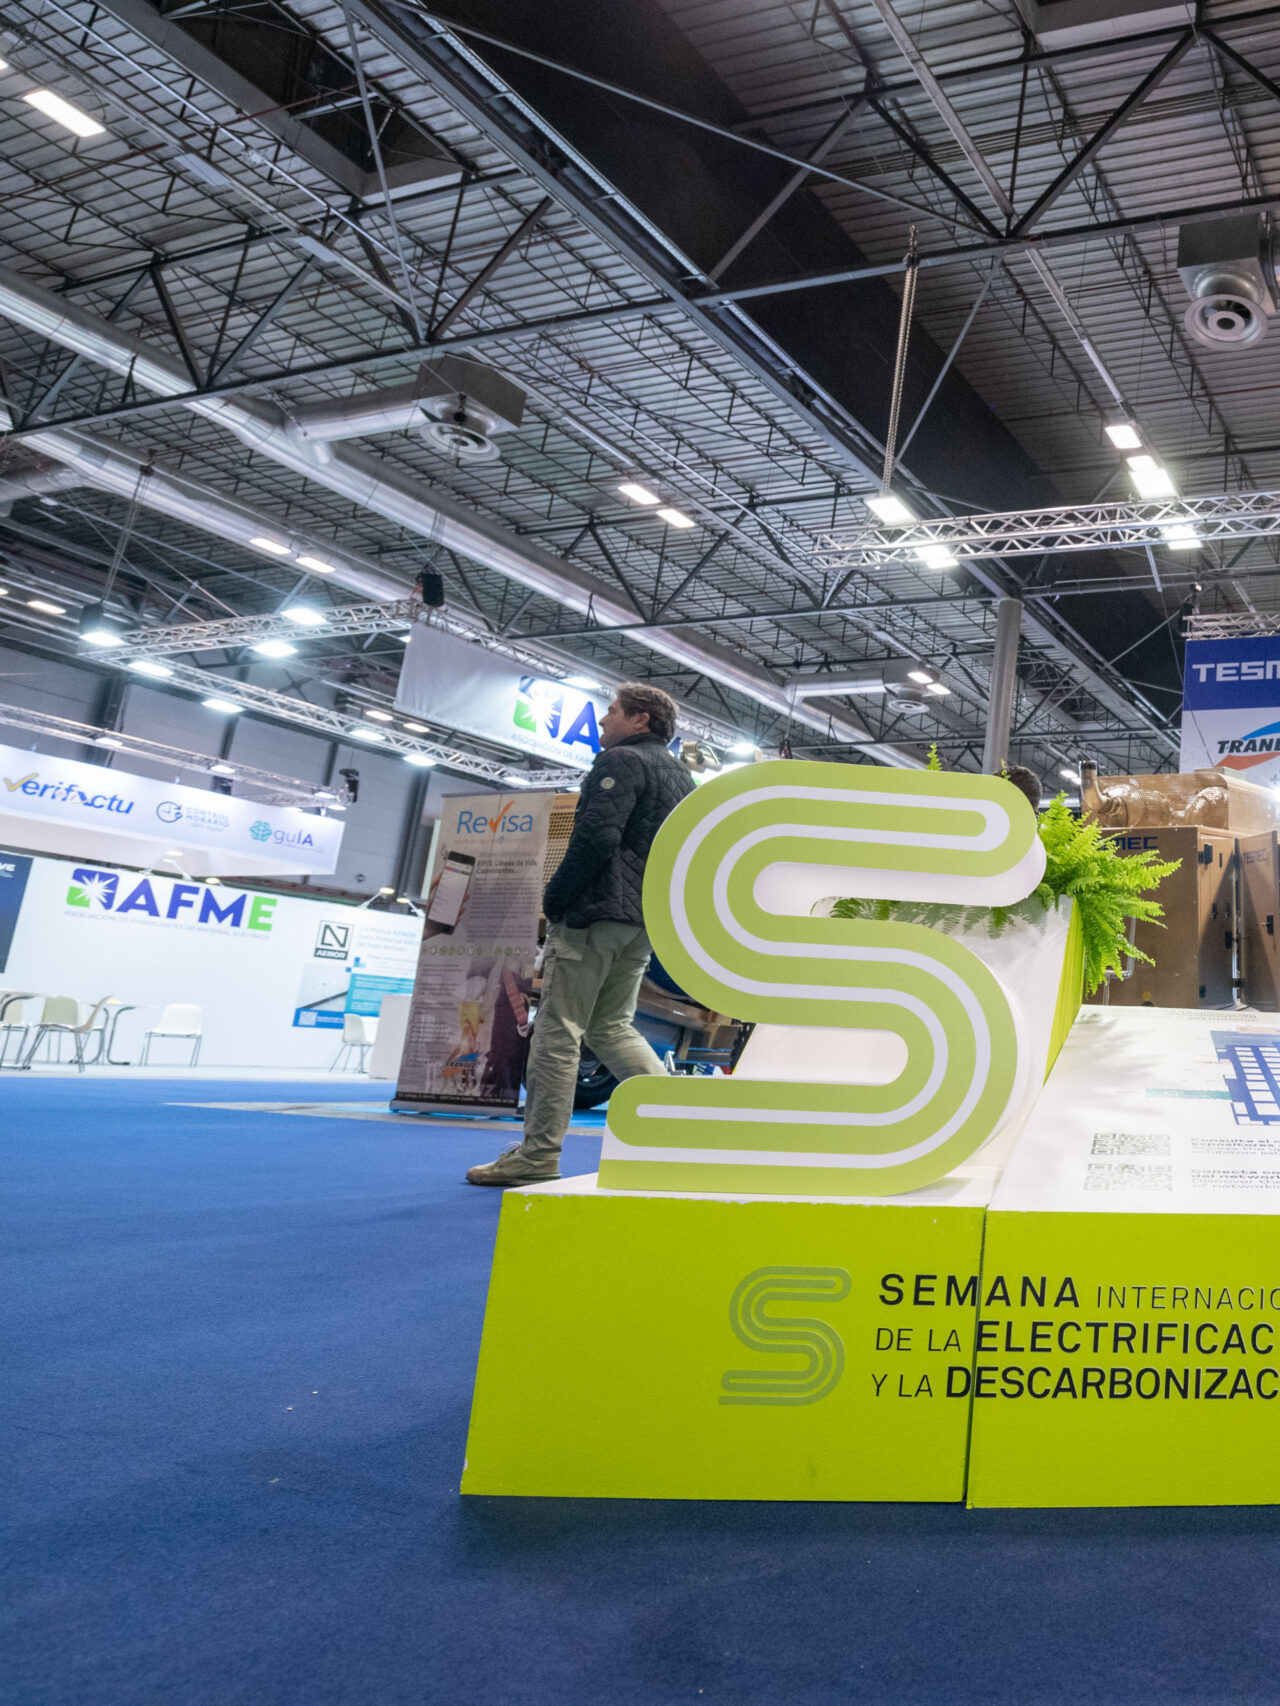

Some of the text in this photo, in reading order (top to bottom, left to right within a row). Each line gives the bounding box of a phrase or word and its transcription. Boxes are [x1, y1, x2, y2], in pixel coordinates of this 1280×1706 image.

[114, 877, 278, 932] AFME
[879, 1273, 1081, 1308] SEMANA
[875, 1327, 914, 1352] DE
[928, 1328, 962, 1353] LA
[871, 1373, 889, 1397] Y
[898, 1373, 934, 1398] LA
